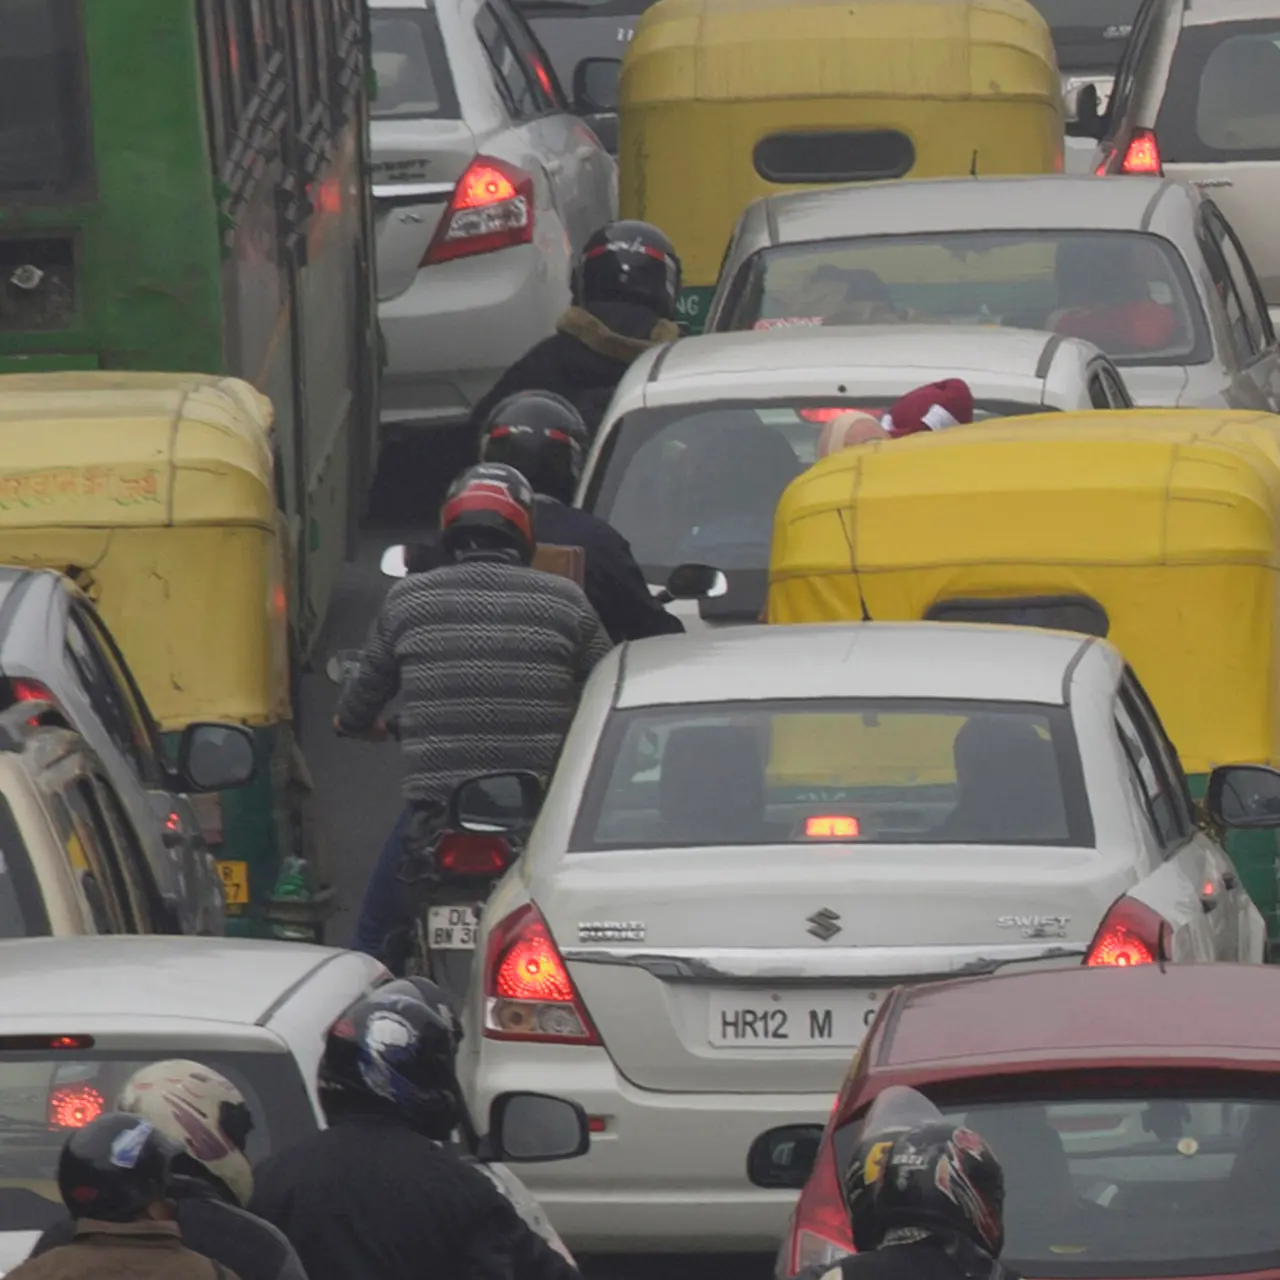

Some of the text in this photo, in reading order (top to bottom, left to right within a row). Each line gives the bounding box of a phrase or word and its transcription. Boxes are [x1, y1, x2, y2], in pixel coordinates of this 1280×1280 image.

[996, 915, 1071, 928] SWIFT
[721, 1009, 788, 1039] HR12
[811, 1009, 833, 1039] M
